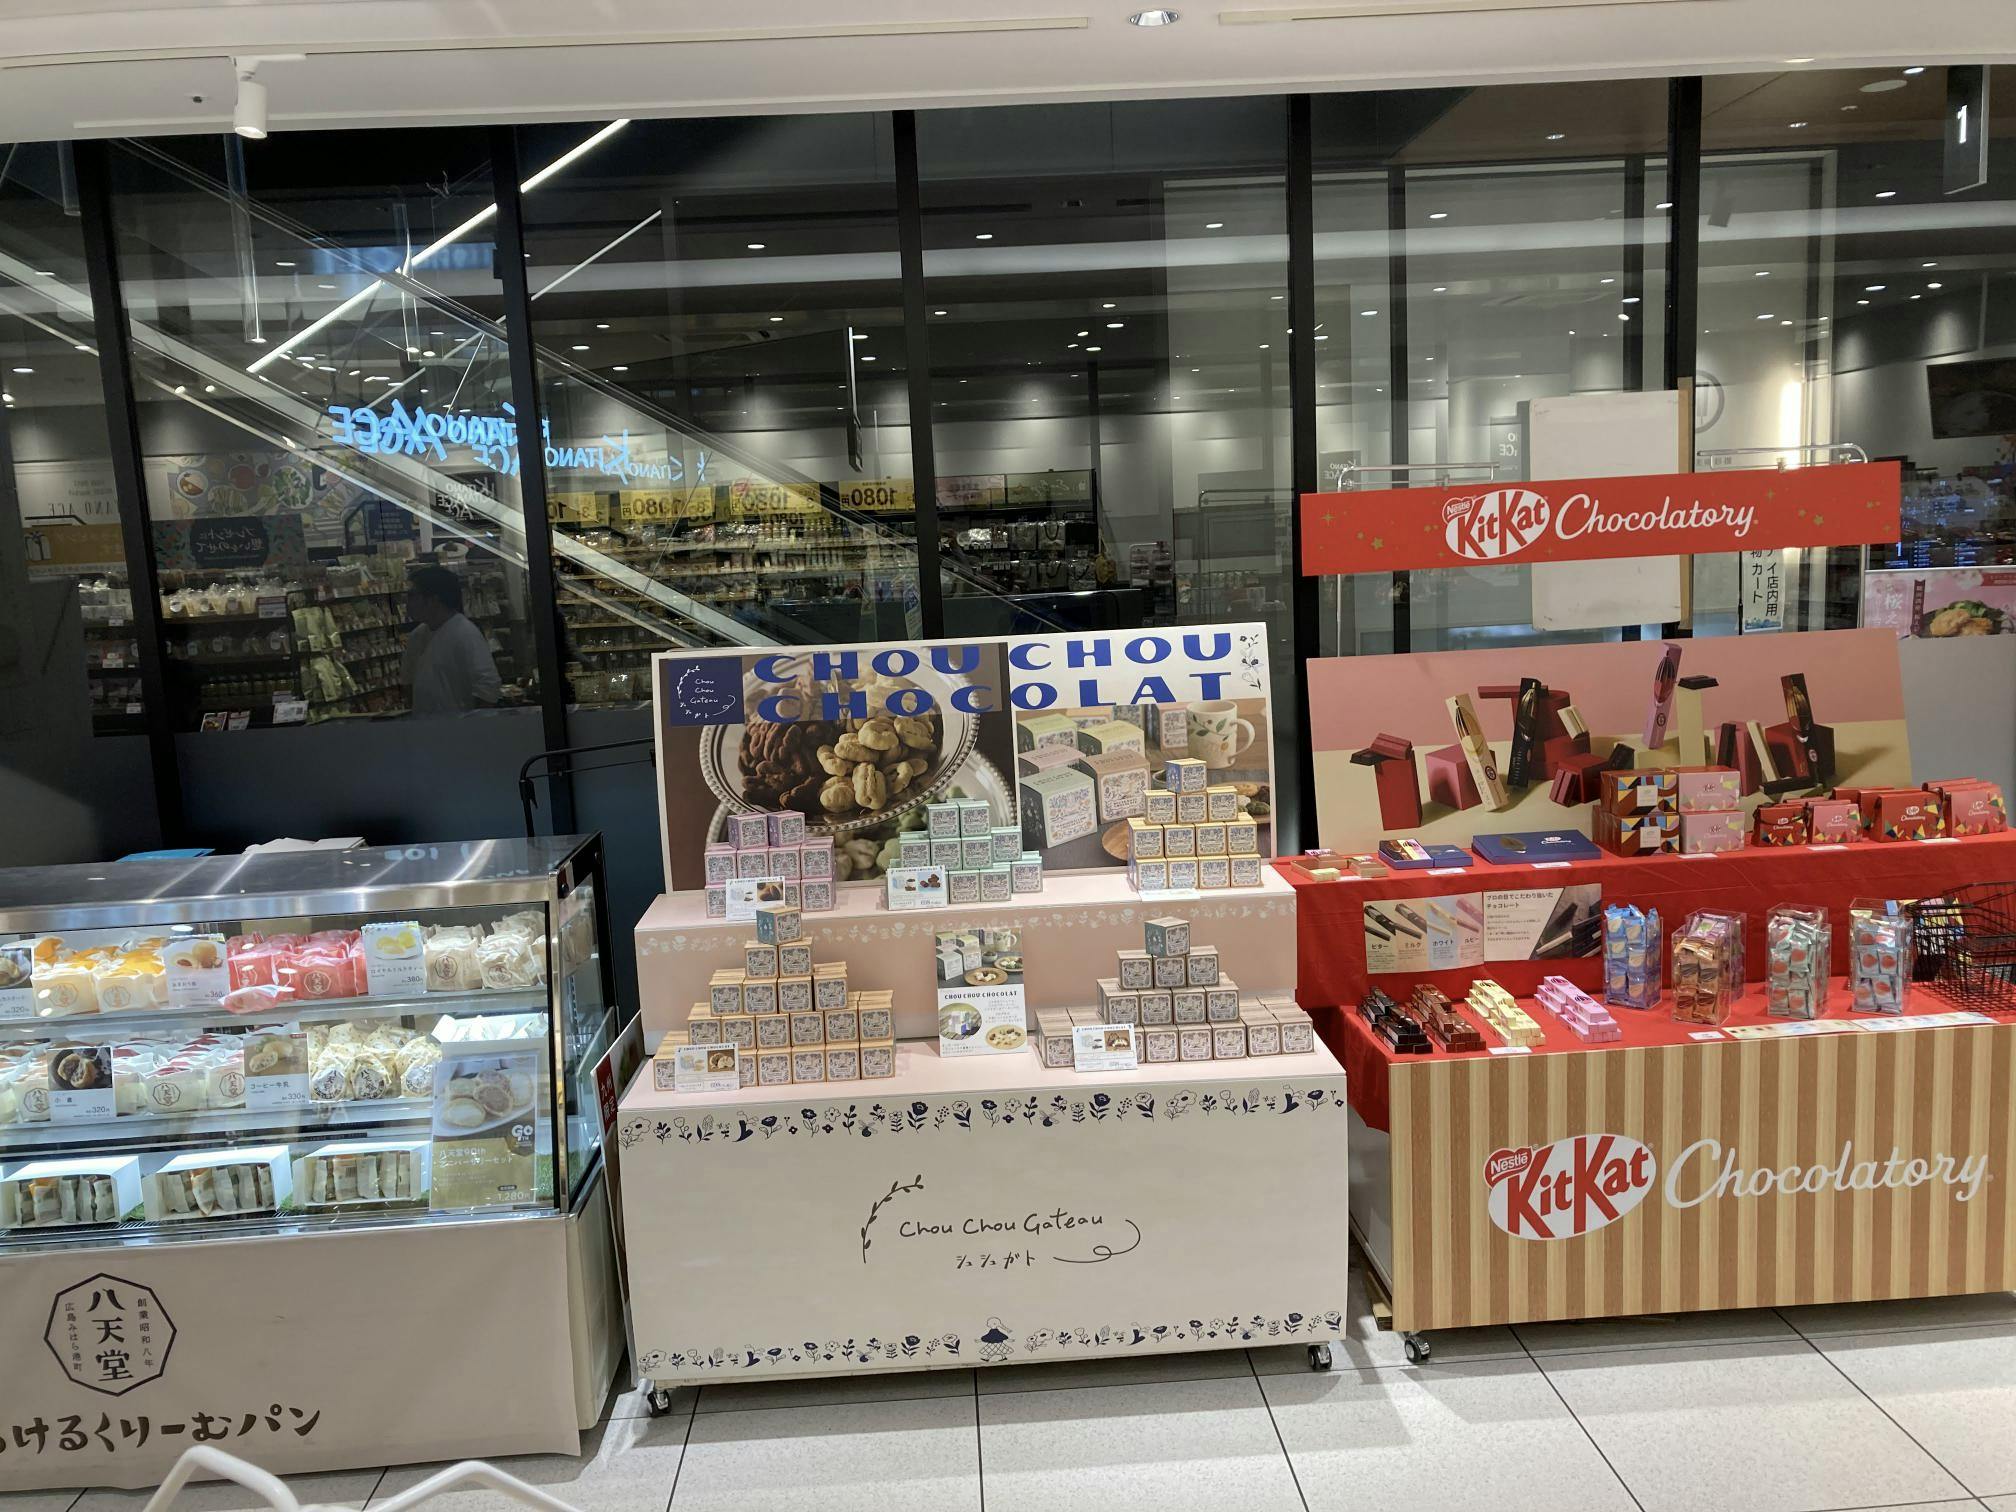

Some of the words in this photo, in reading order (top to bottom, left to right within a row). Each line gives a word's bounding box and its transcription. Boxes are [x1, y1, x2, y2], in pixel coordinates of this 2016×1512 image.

[1457, 490, 1546, 558] KitKat
[1555, 493, 1754, 540] Chocolatory
[754, 645, 981, 685] CHOU
[1009, 632, 1233, 671] CHOU
[757, 671, 1233, 724] CHOCOLAT
[982, 991, 1018, 999] CHOCOLAT
[1507, 1135, 1650, 1239] KitKat
[1665, 1138, 1988, 1210] Chocolatory
[899, 1217, 954, 1239] Chou
[962, 1214, 1017, 1235] Chou
[1023, 1207, 1105, 1235] Gateau
[64, 1301, 83, 1373] 広島みはら港町
[86, 1287, 135, 1382] 八天堂
[136, 1297, 154, 1369] 創業昭和八年
